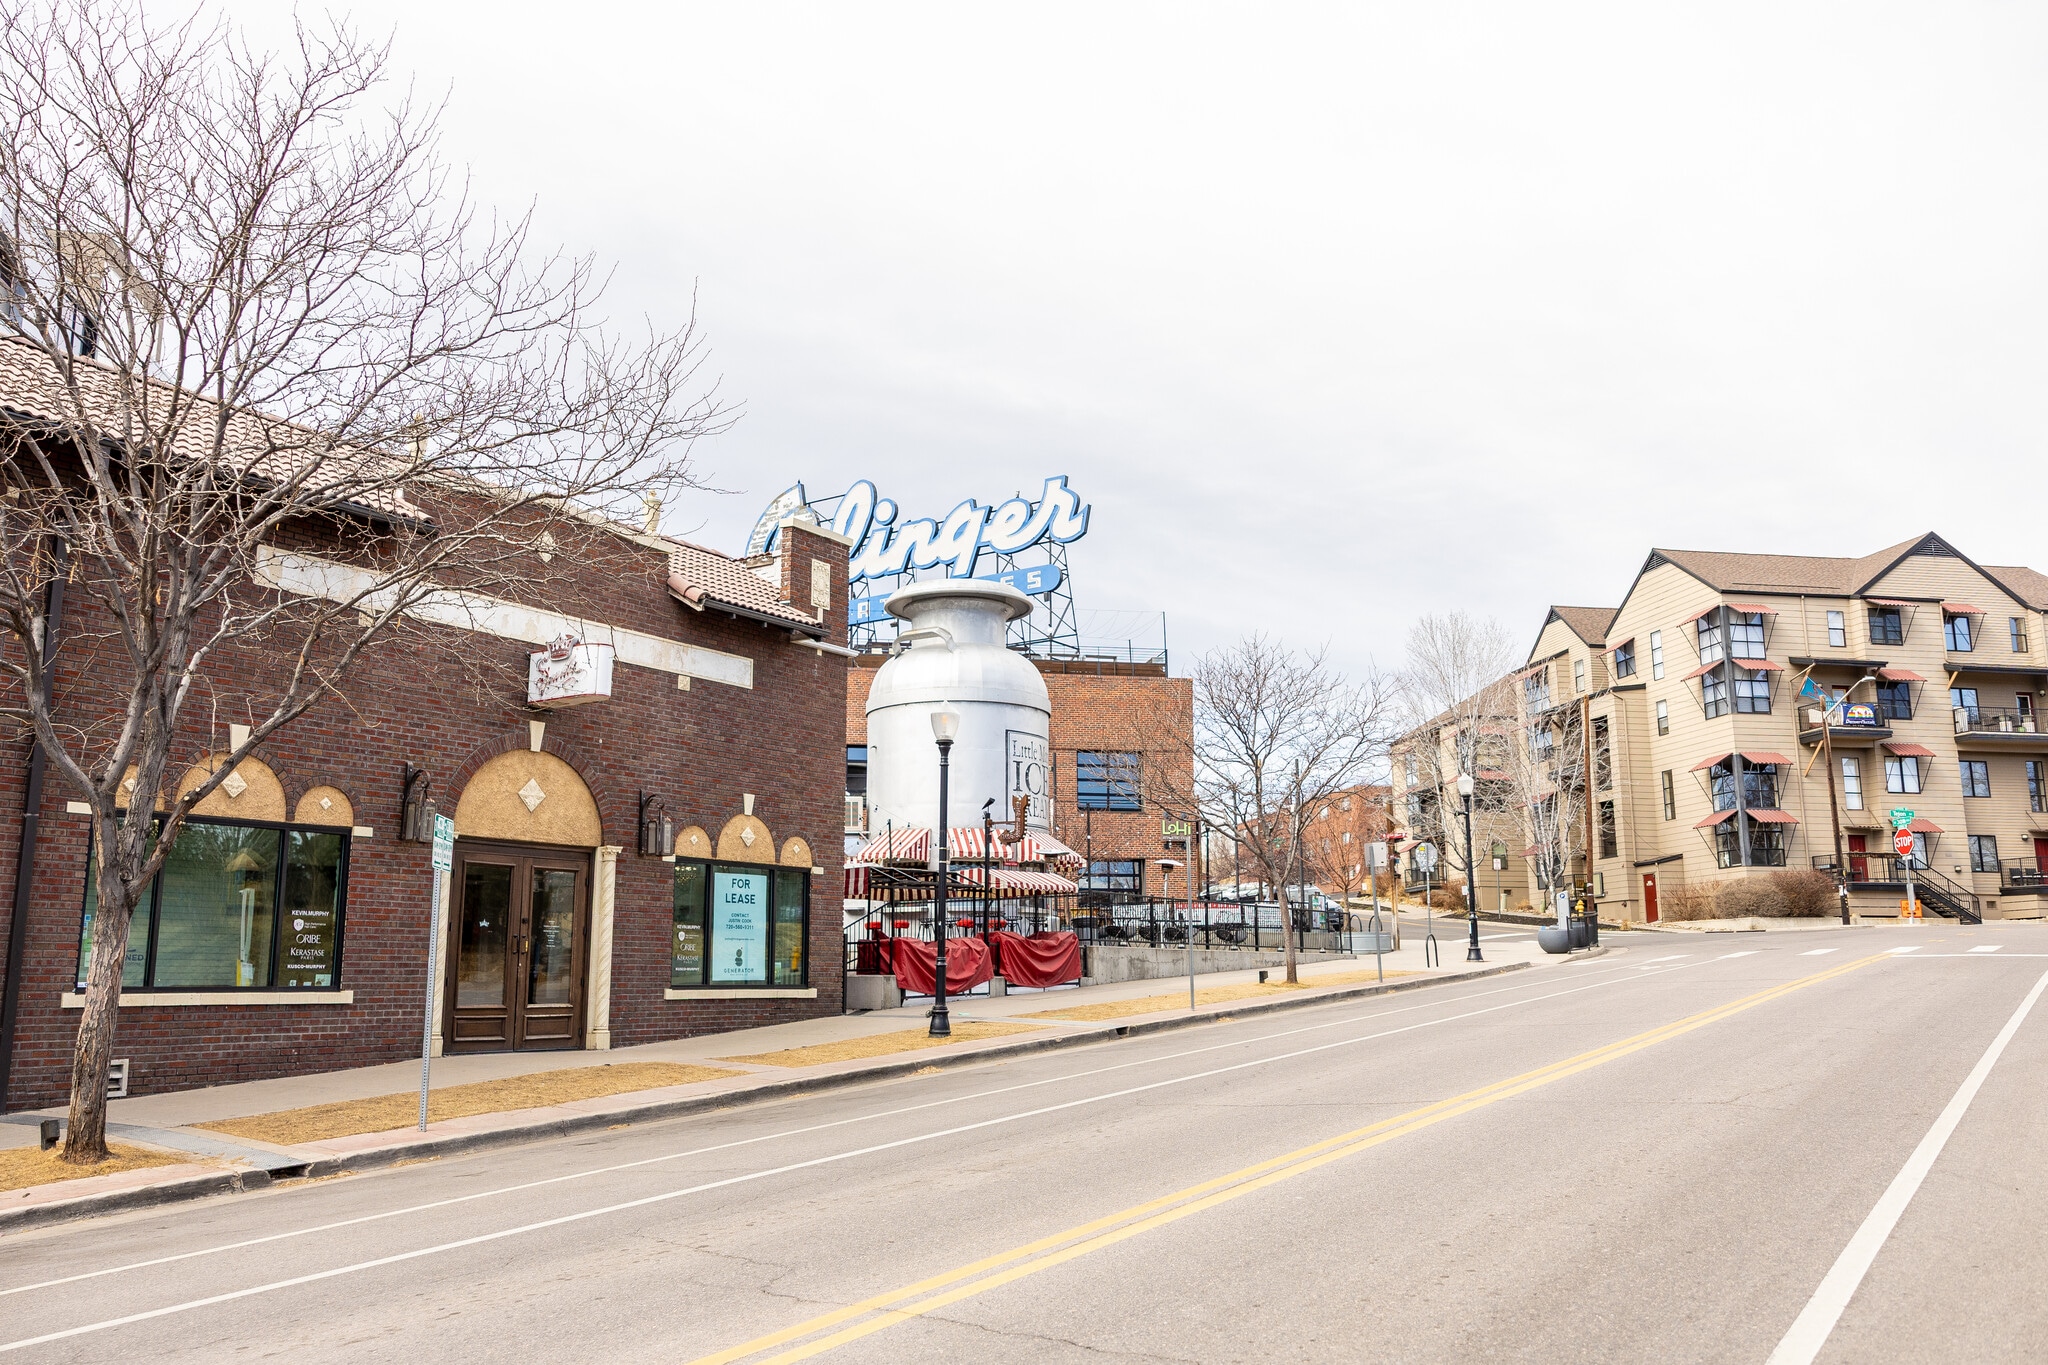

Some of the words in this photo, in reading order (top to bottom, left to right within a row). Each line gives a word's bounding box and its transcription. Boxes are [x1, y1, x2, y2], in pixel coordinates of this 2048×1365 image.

[1012, 739, 1037, 760] Little
[1012, 760, 1048, 797] ICE
[1893, 811, 1906, 819] Tejon
[1162, 820, 1192, 836] LoHi
[1895, 836, 1912, 847] STOP
[731, 878, 751, 889] FOR
[725, 893, 756, 904] LEASE
[296, 933, 321, 944] ORIBE
